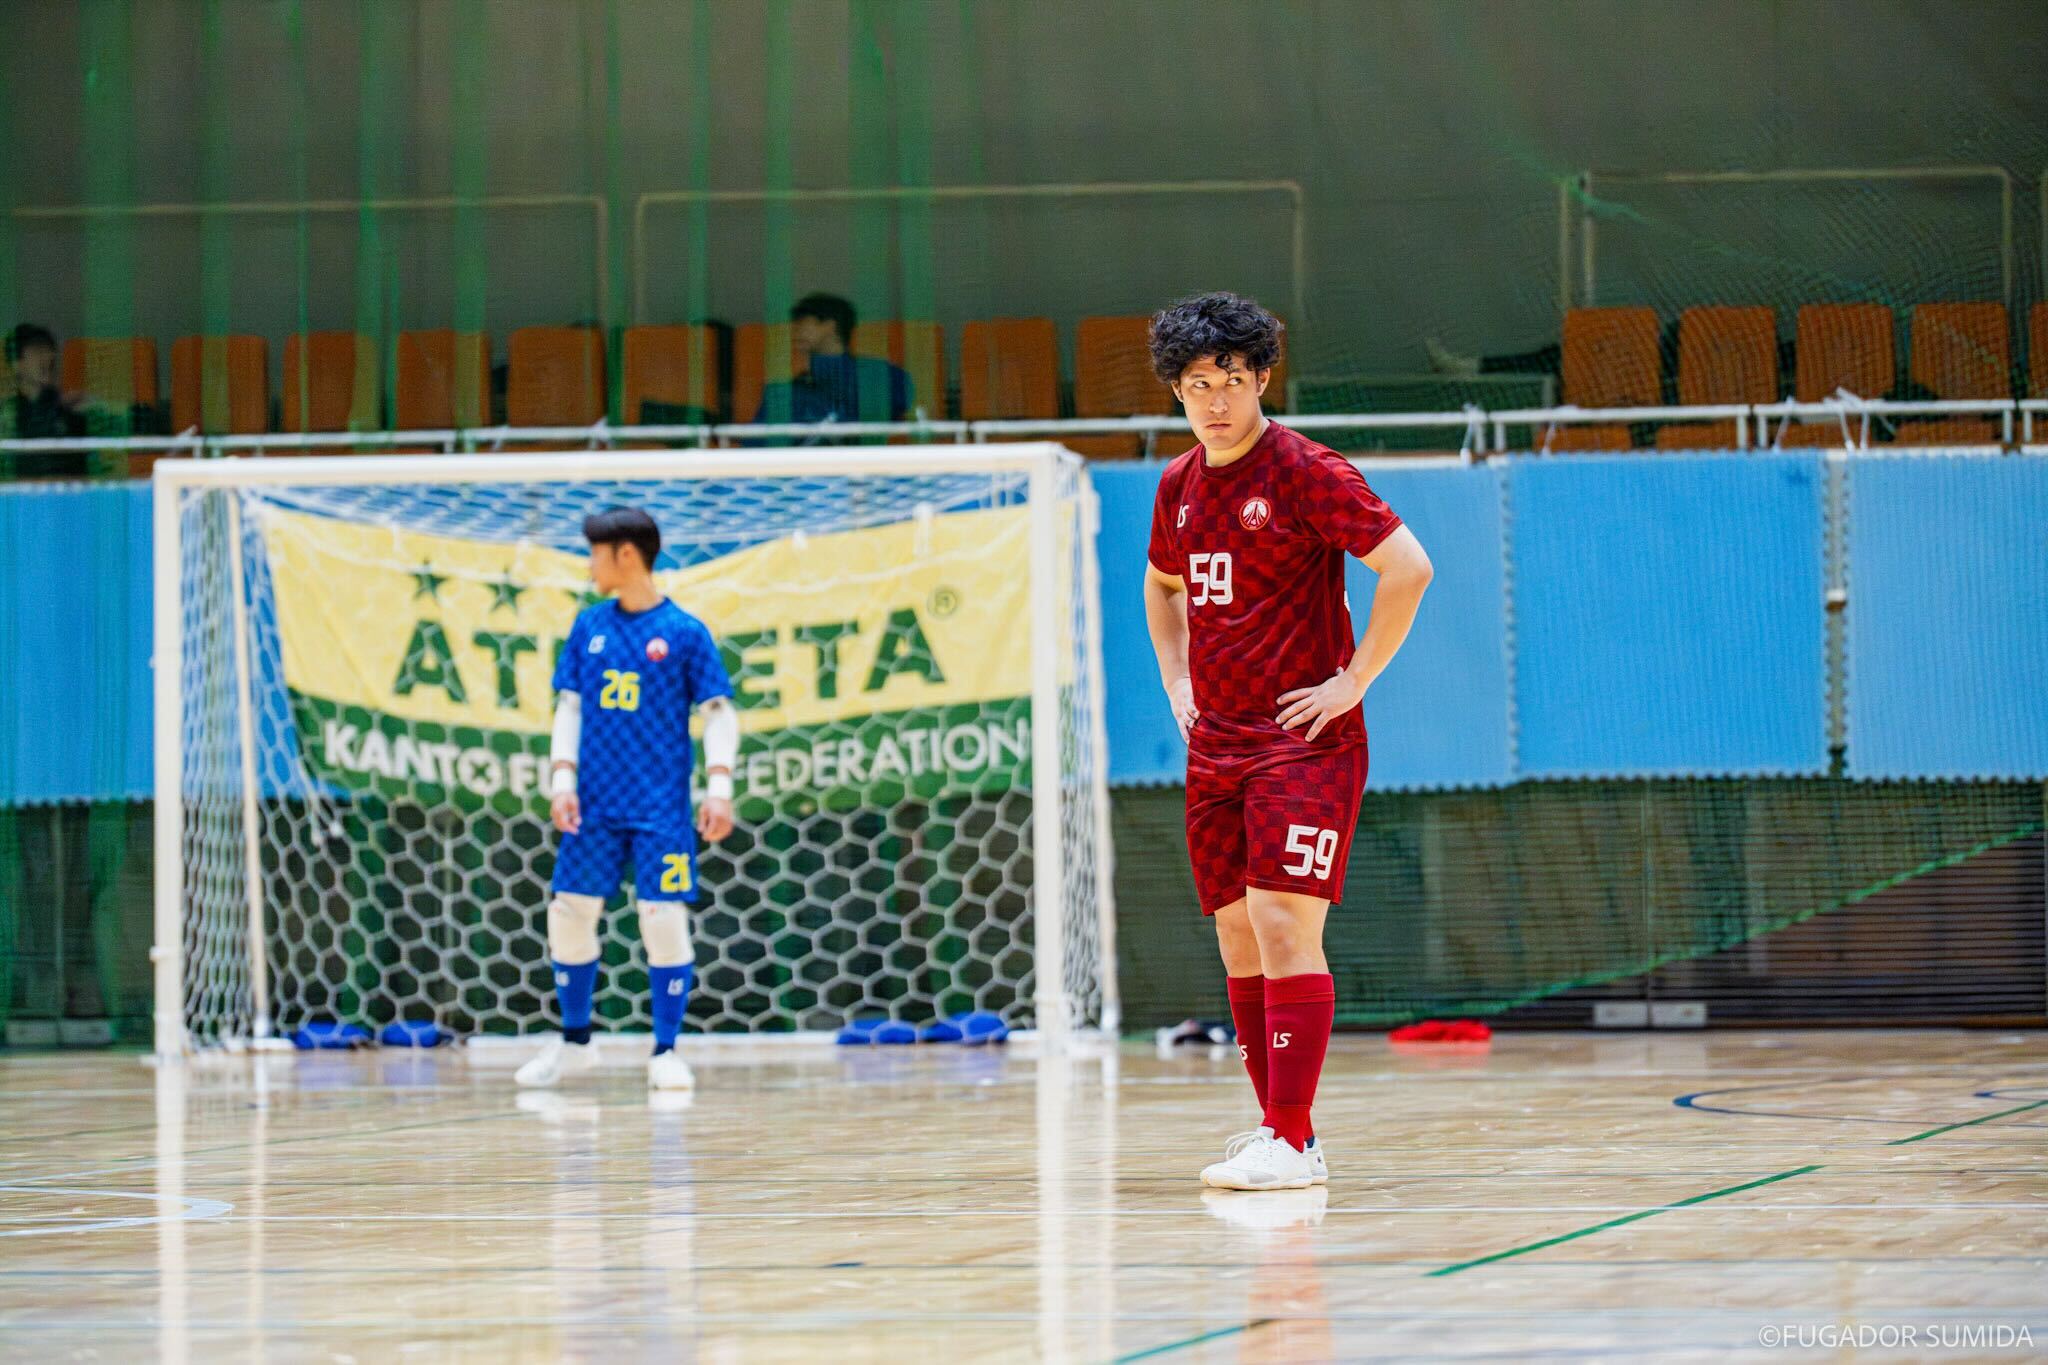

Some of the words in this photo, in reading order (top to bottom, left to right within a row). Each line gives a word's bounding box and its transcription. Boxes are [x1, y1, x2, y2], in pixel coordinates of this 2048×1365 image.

[1189, 552, 1233, 606] 59
[393, 607, 945, 711] ATETA
[600, 669, 640, 711] 26
[324, 719, 500, 796] KANTO
[733, 716, 1030, 798] EDERATION
[1282, 823, 1339, 880] 59
